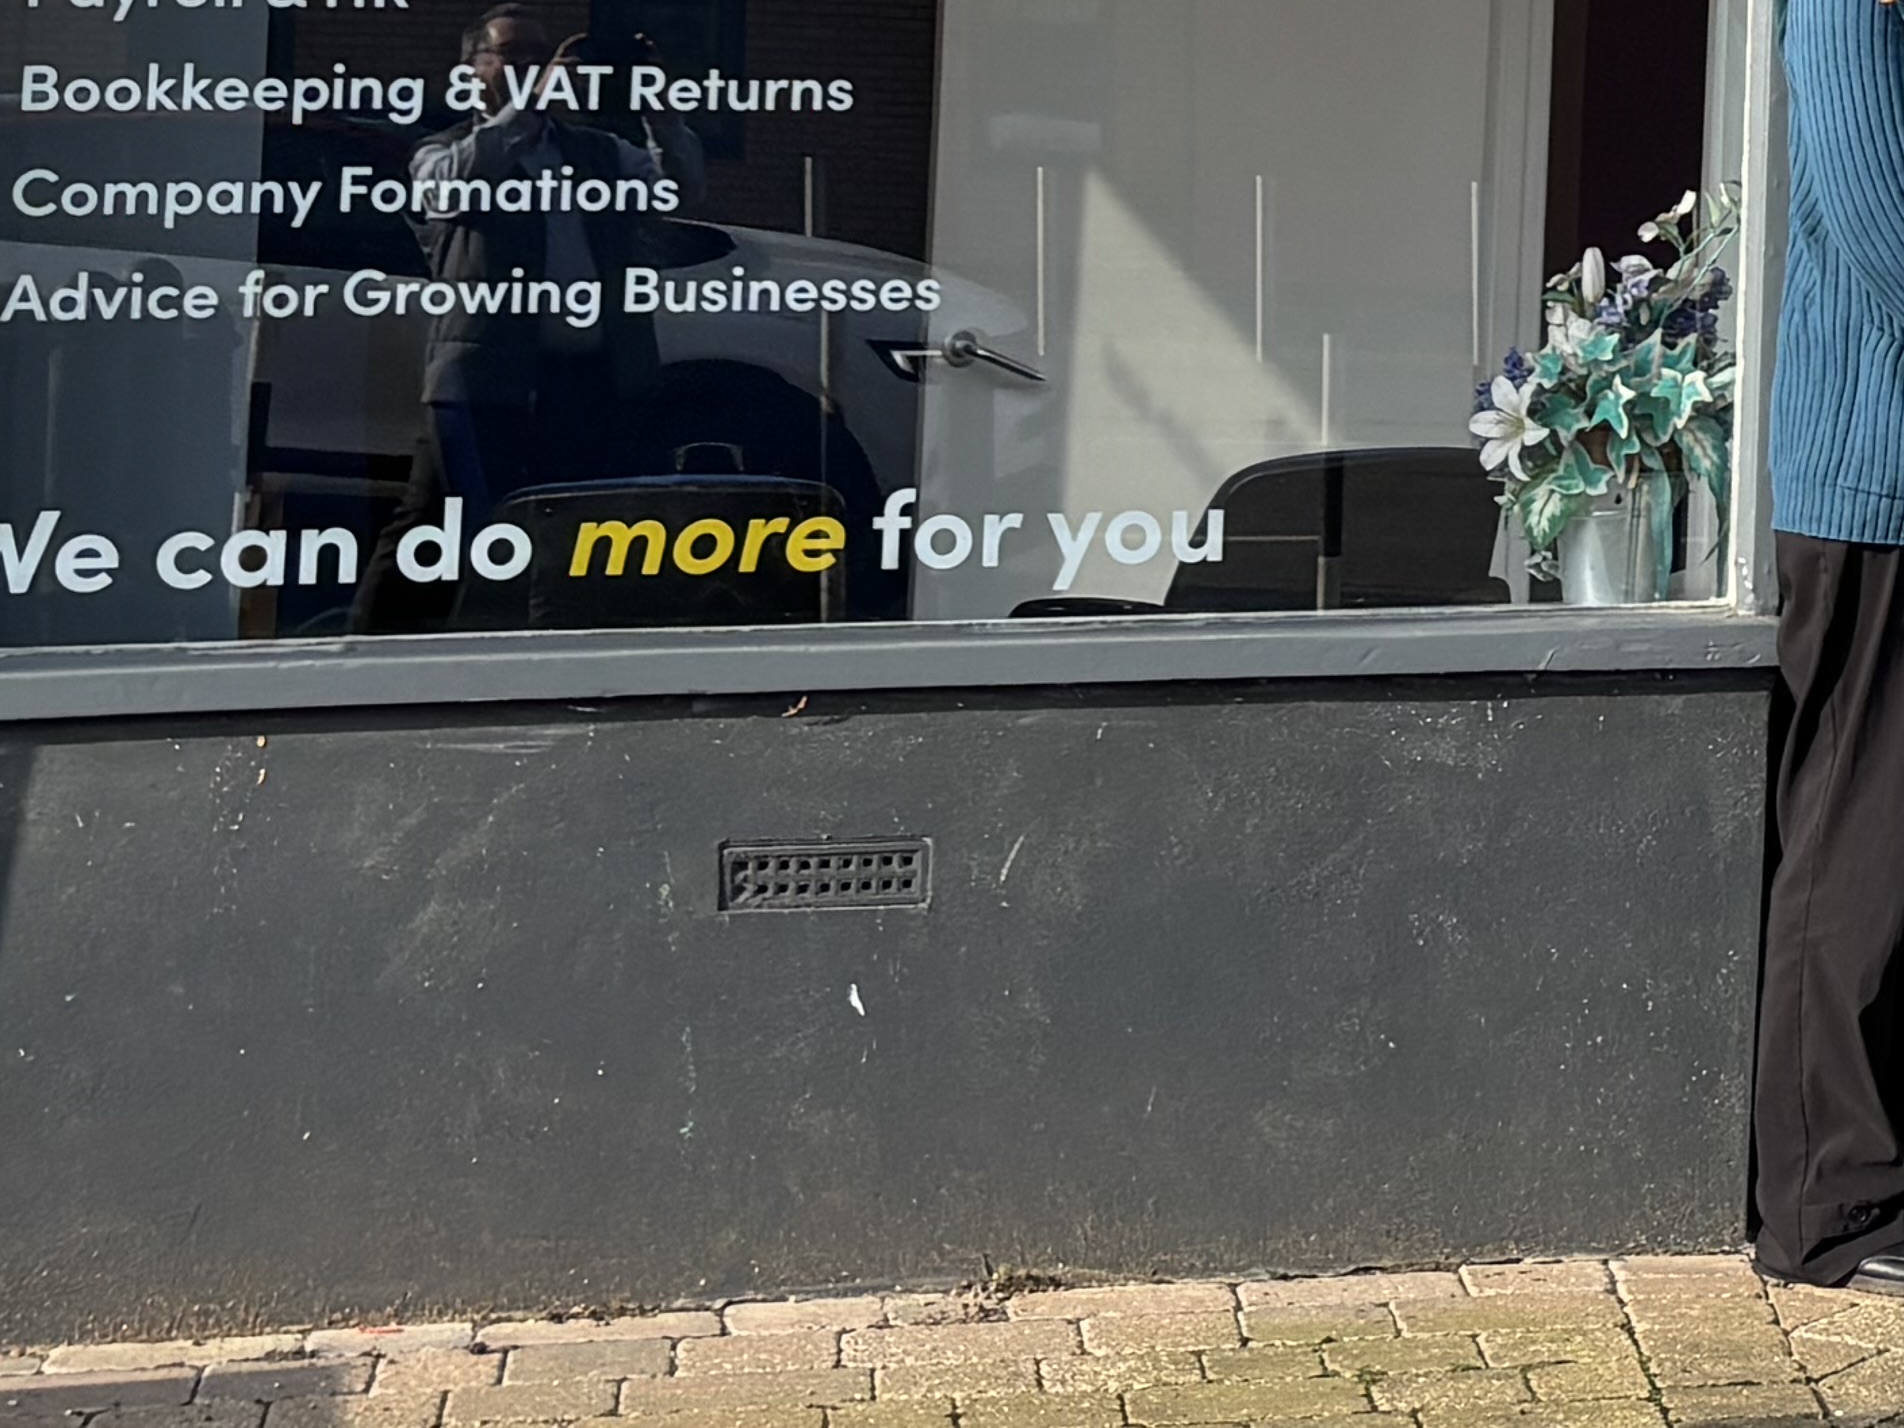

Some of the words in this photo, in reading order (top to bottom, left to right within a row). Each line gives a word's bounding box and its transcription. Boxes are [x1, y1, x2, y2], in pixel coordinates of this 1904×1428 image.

[20, 61, 425, 126] Bookkeeping
[444, 63, 487, 112] &
[502, 65, 613, 111] VAT
[628, 64, 855, 112] Returns
[12, 168, 322, 228] Company
[338, 164, 681, 214] Formations
[0, 271, 220, 322] Advice
[239, 269, 329, 318] for
[343, 266, 602, 328] Growing
[623, 265, 942, 314] Businesses
[155, 518, 359, 591] can
[394, 496, 533, 581] do
[568, 510, 846, 577] more
[871, 487, 1023, 572] for
[1046, 506, 1224, 591] you
